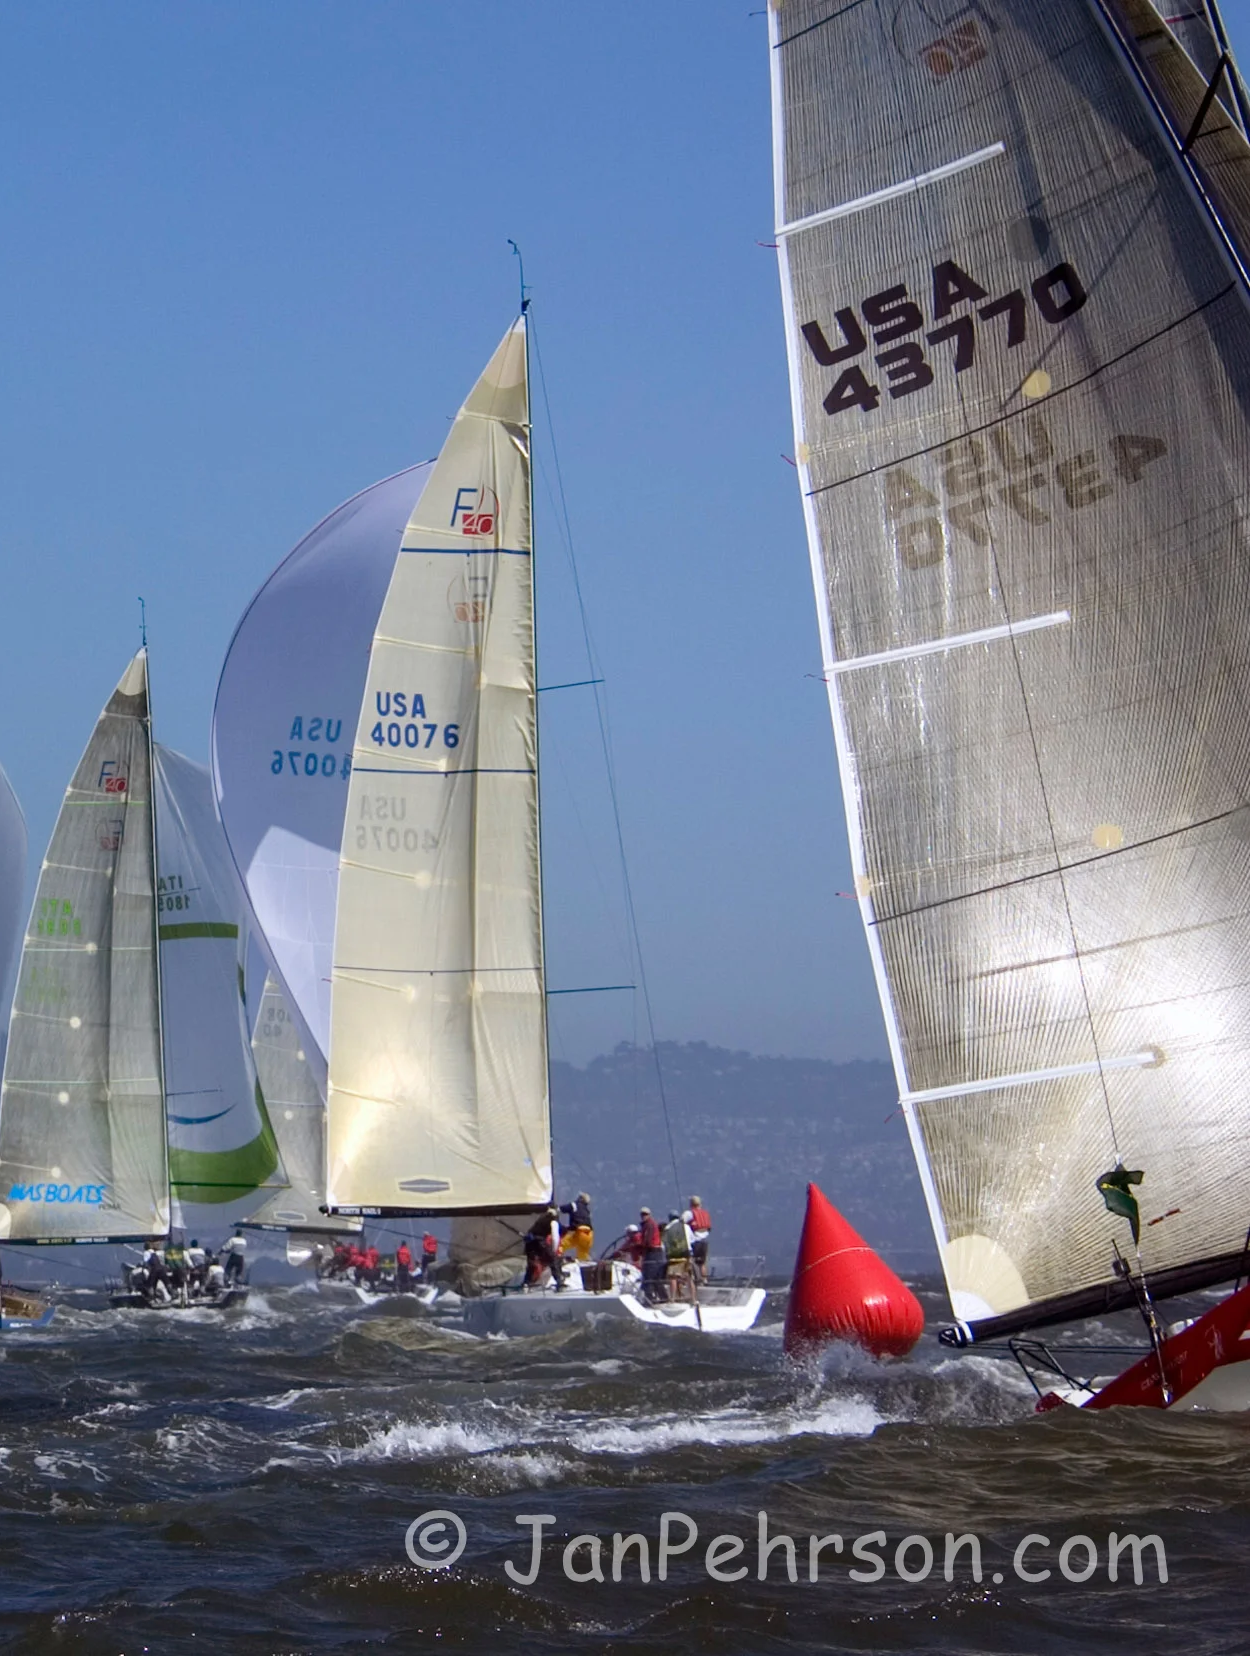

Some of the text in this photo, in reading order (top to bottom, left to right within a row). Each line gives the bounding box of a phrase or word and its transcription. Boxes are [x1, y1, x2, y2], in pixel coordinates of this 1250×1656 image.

[800, 260, 989, 367] USA
[822, 262, 1088, 416] 43770
[376, 691, 426, 719] USA
[370, 720, 460, 749] 40076
[42, 898, 72, 916] ITA
